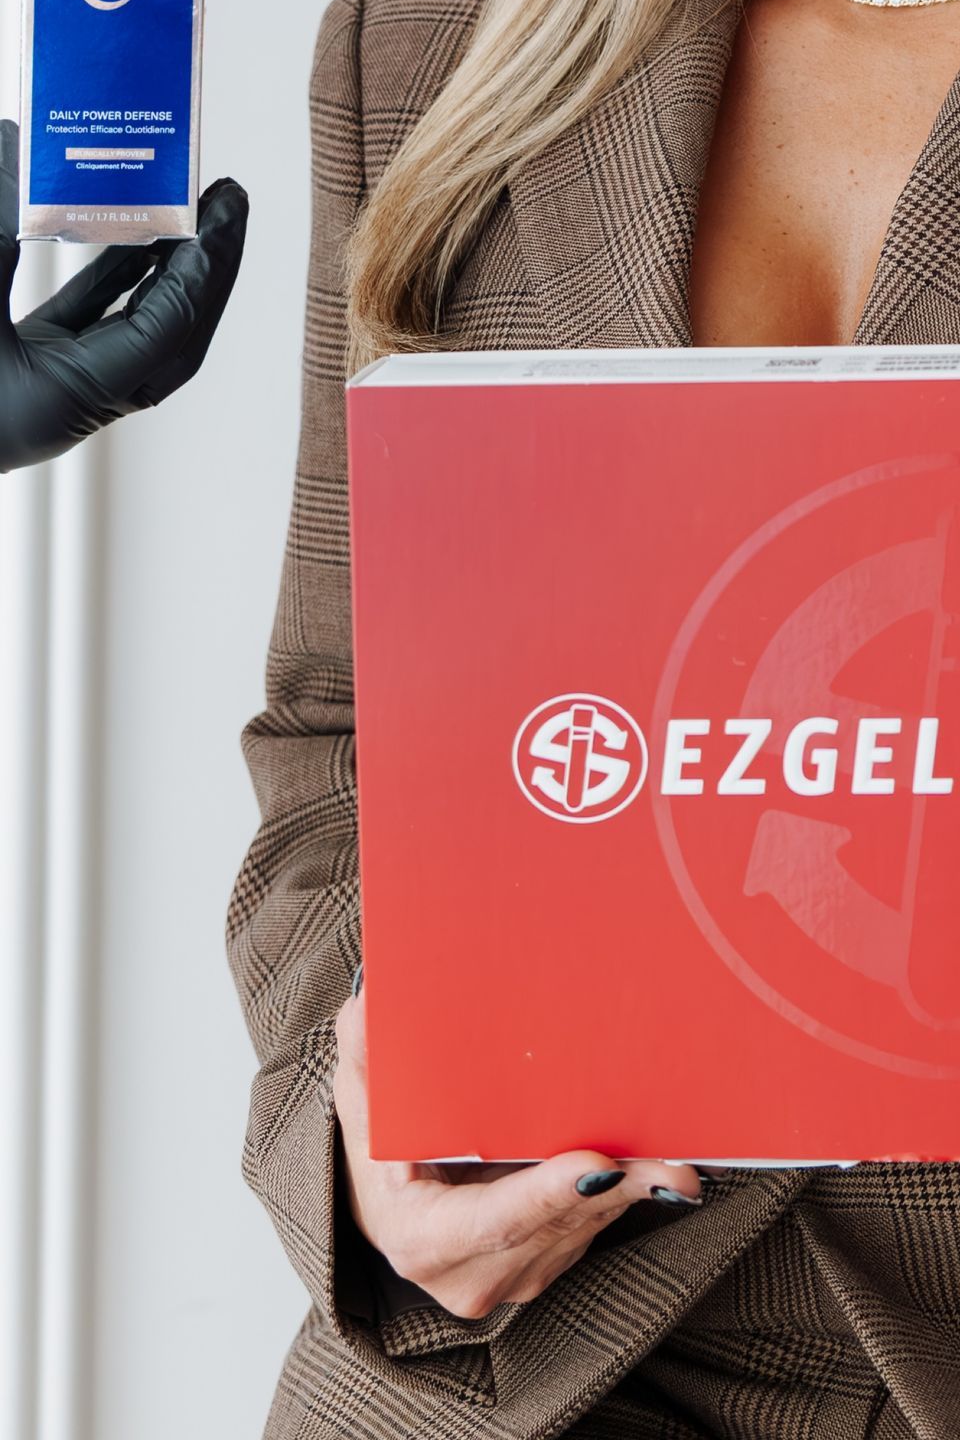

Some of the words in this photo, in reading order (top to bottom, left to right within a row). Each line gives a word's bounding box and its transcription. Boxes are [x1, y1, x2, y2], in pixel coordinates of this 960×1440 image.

[50, 110, 80, 121] DAILY
[82, 110, 122, 121] POWER
[124, 111, 172, 121] DEFENSE
[46, 124, 88, 134] Protection
[90, 124, 123, 134] Efficace
[125, 125, 176, 134] Quotidienne
[116, 151, 146, 159] PROVEN
[76, 162, 120, 170] Cliniquement
[66, 212, 76, 222] 50
[96, 212, 108, 222] 1.7
[134, 212, 151, 222] U.S.
[660, 717, 954, 796] EZGEL
